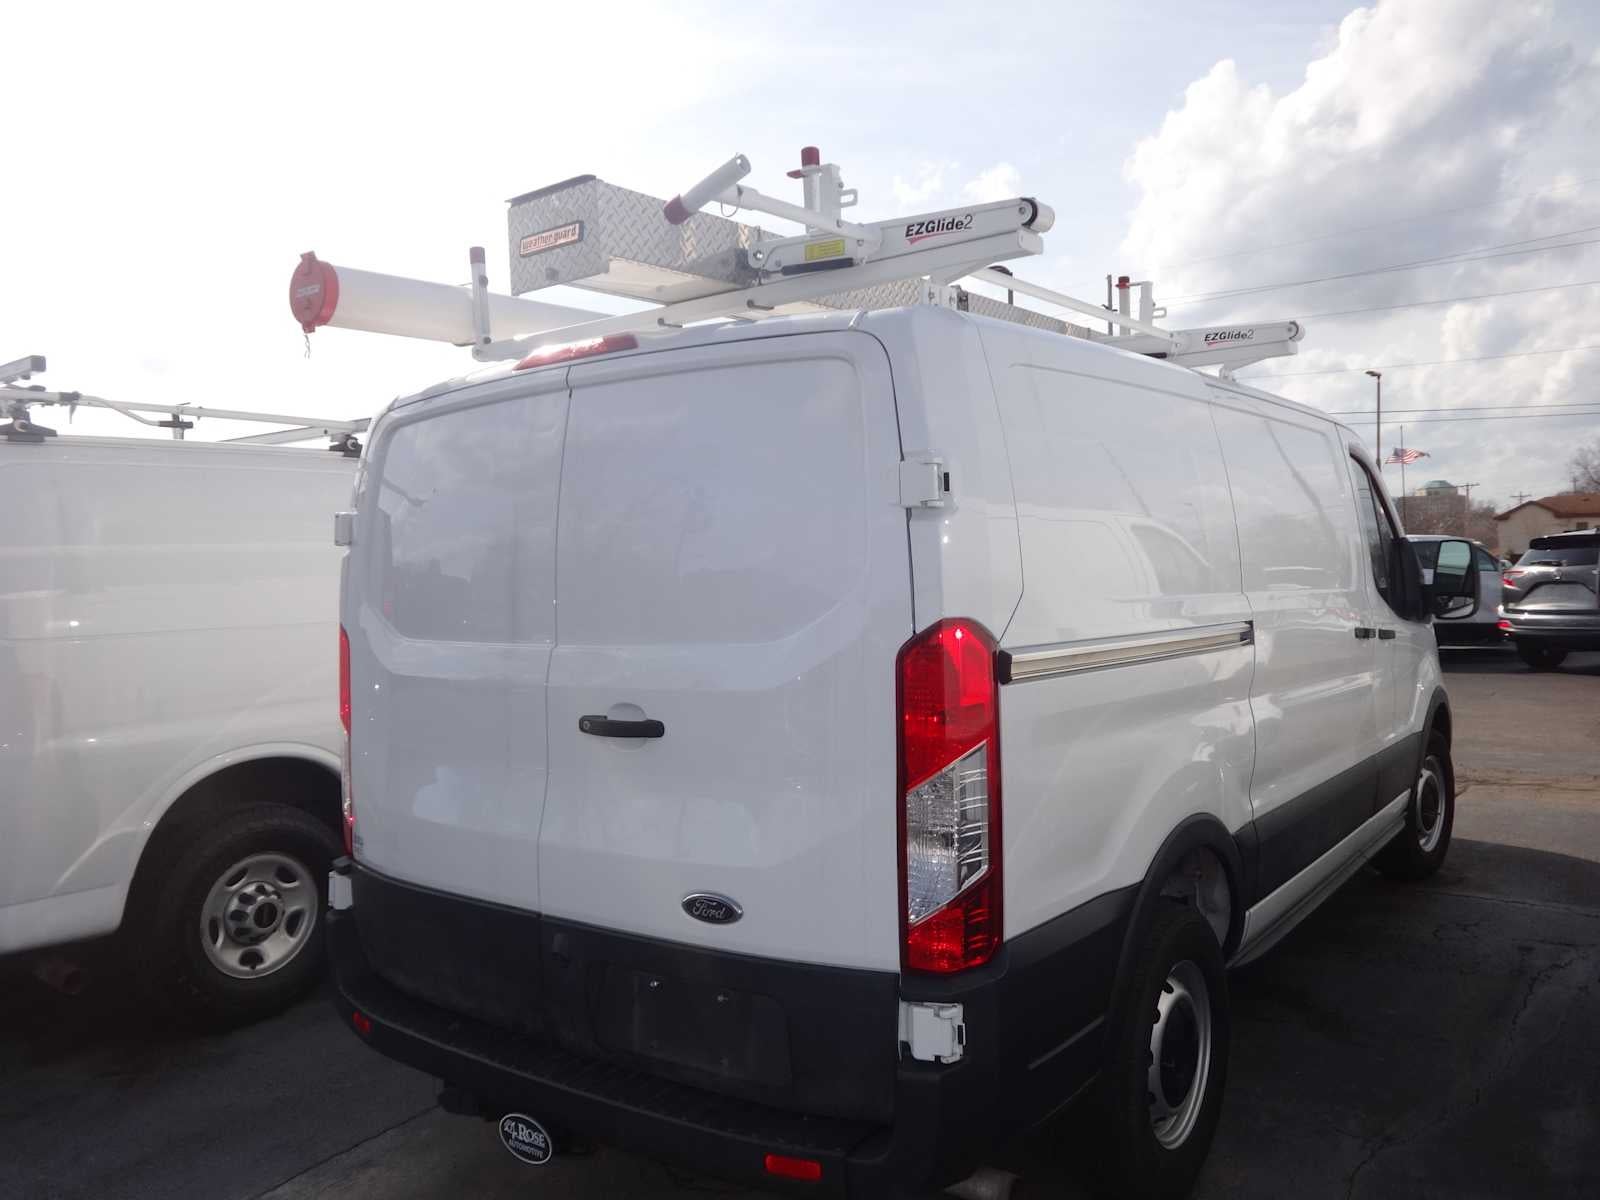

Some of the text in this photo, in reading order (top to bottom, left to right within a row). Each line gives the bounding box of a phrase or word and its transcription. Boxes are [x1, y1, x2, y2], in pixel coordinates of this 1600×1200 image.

[905, 214, 973, 237] EZGlide2
[1204, 329, 1254, 342] EZGlide2
[692, 899, 726, 919] Ford
